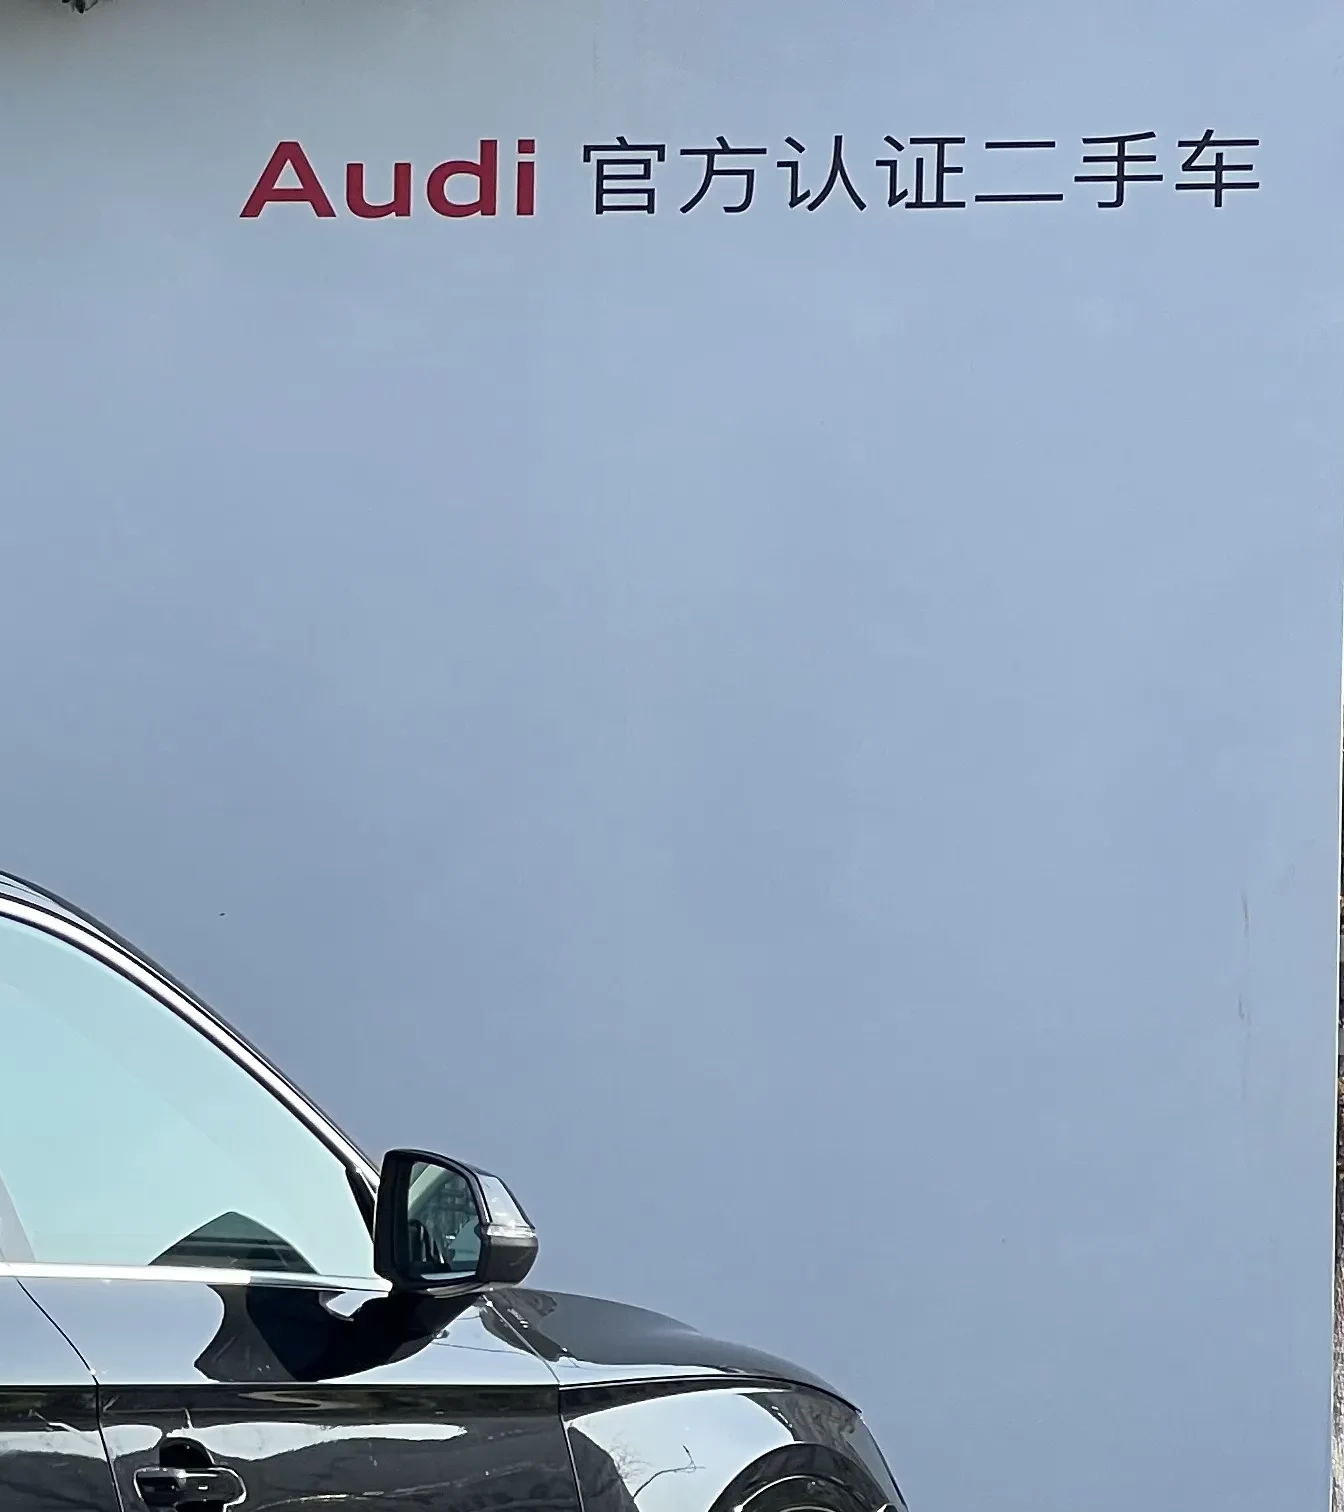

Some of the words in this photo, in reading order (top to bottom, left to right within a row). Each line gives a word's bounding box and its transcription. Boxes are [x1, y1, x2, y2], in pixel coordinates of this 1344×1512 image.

[238, 138, 538, 219] Audi
[581, 129, 1263, 215] 官方认证二手车
